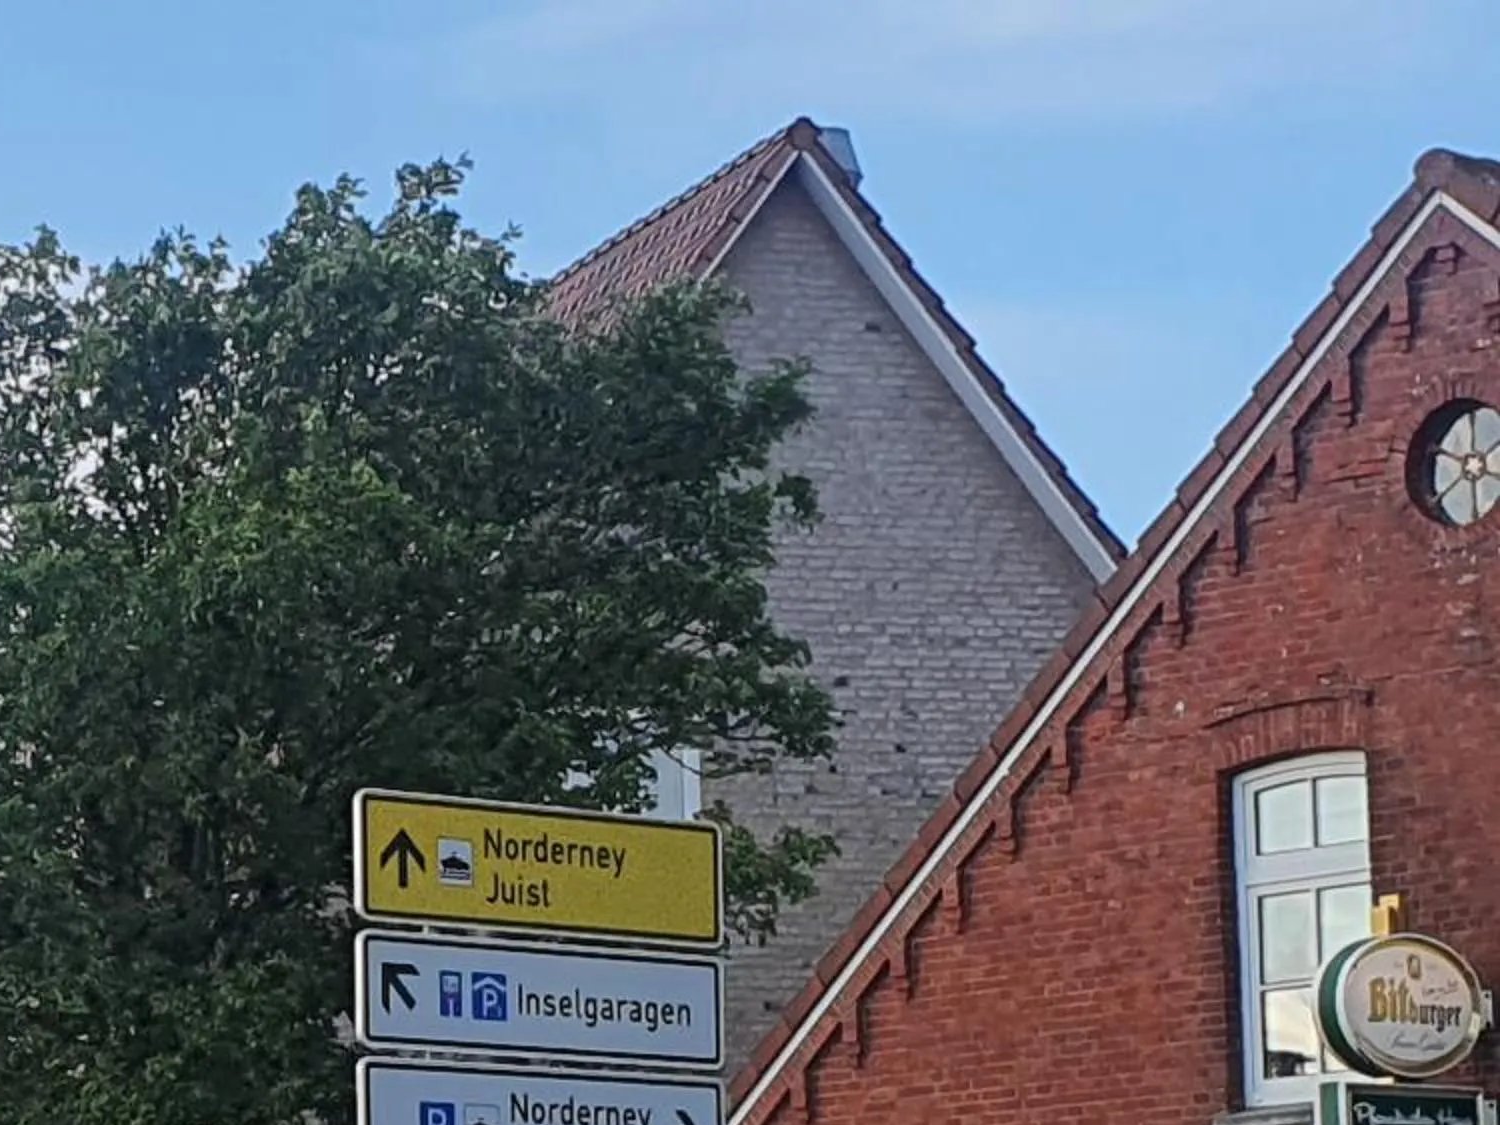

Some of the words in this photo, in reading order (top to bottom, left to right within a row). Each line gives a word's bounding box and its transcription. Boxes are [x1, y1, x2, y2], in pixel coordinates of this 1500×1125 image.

[483, 828, 627, 879] Norderney
[485, 873, 551, 908] Juist
[517, 983, 692, 1033] Inselgaragen
[1367, 976, 1462, 1033] Bitburger
